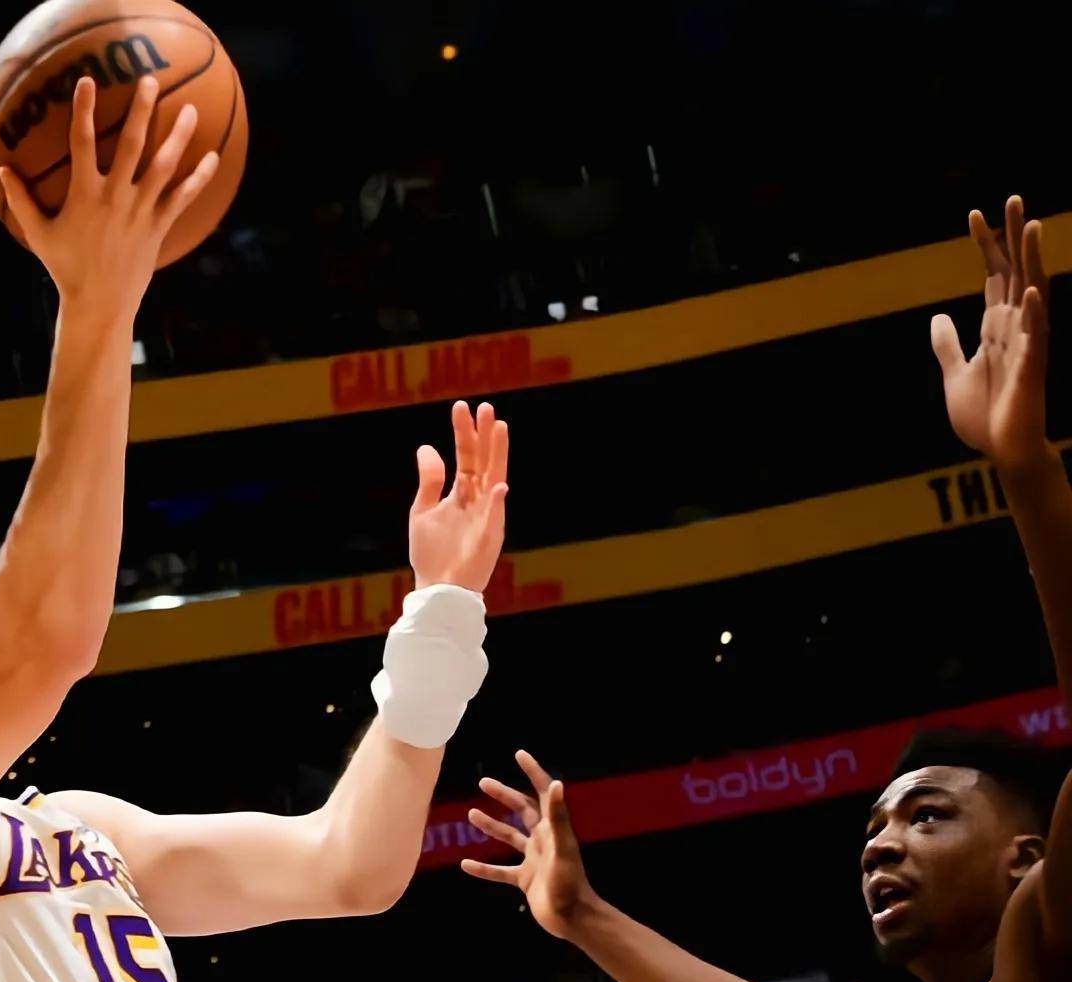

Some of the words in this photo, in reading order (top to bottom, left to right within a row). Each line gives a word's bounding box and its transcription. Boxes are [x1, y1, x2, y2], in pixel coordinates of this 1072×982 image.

[332, 352, 415, 411] CALL
[274, 580, 375, 644] CALL
[683, 748, 858, 806] boldyn
